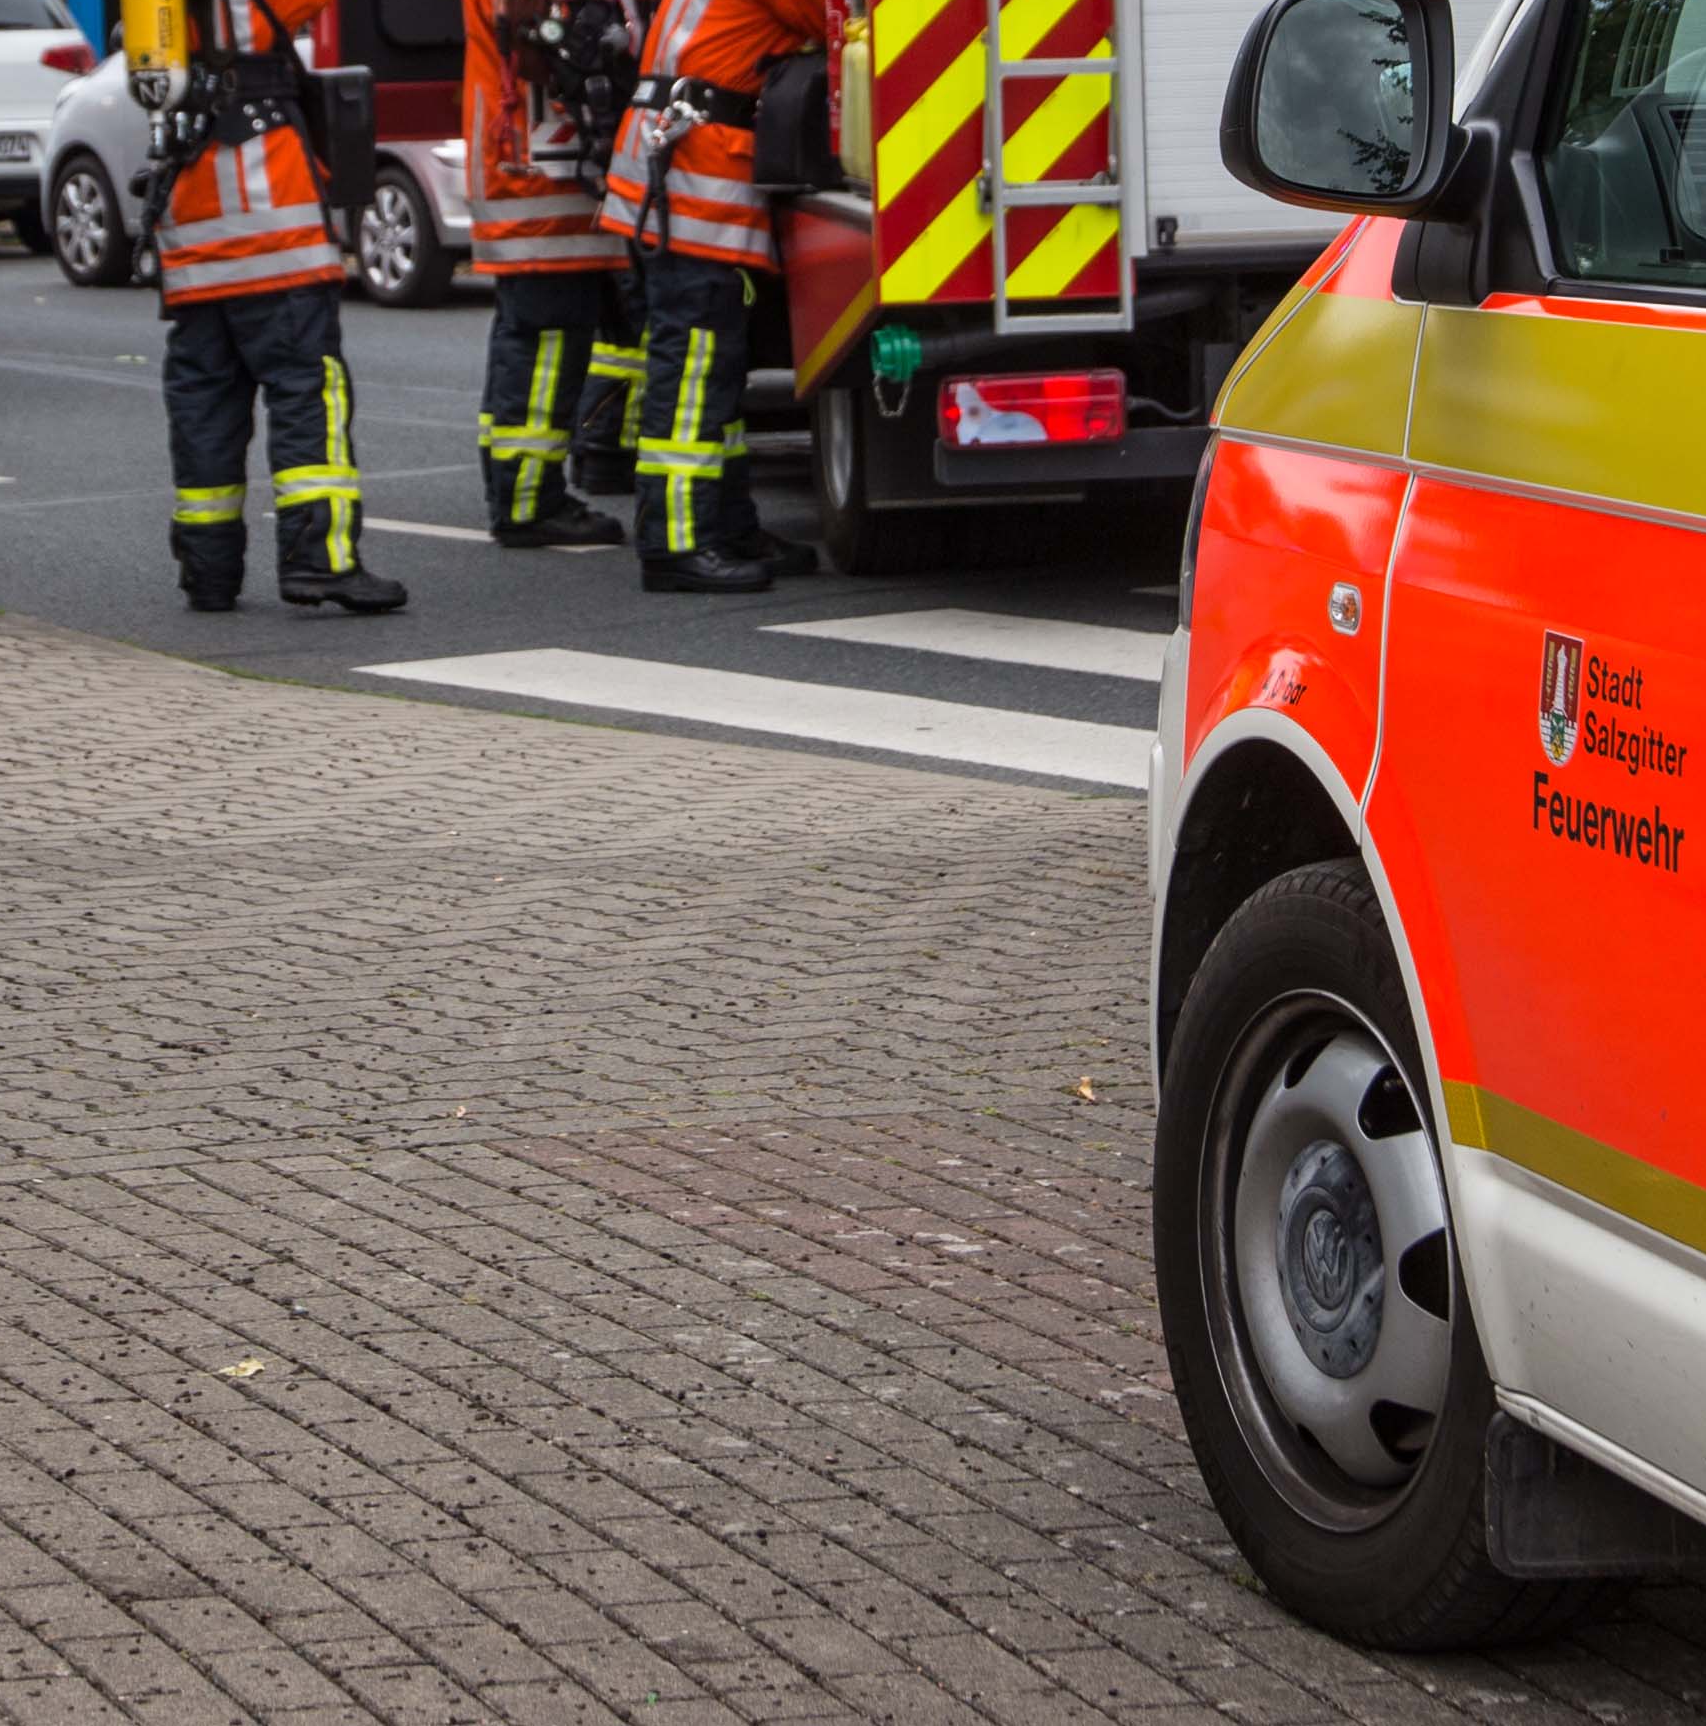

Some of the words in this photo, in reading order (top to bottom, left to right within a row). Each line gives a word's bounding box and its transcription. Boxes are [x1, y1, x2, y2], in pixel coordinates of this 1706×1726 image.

[1586, 655, 1644, 710] Stadt
[1583, 710, 1688, 777] Salzgitter
[1533, 770, 1685, 873] Feuerwehr
